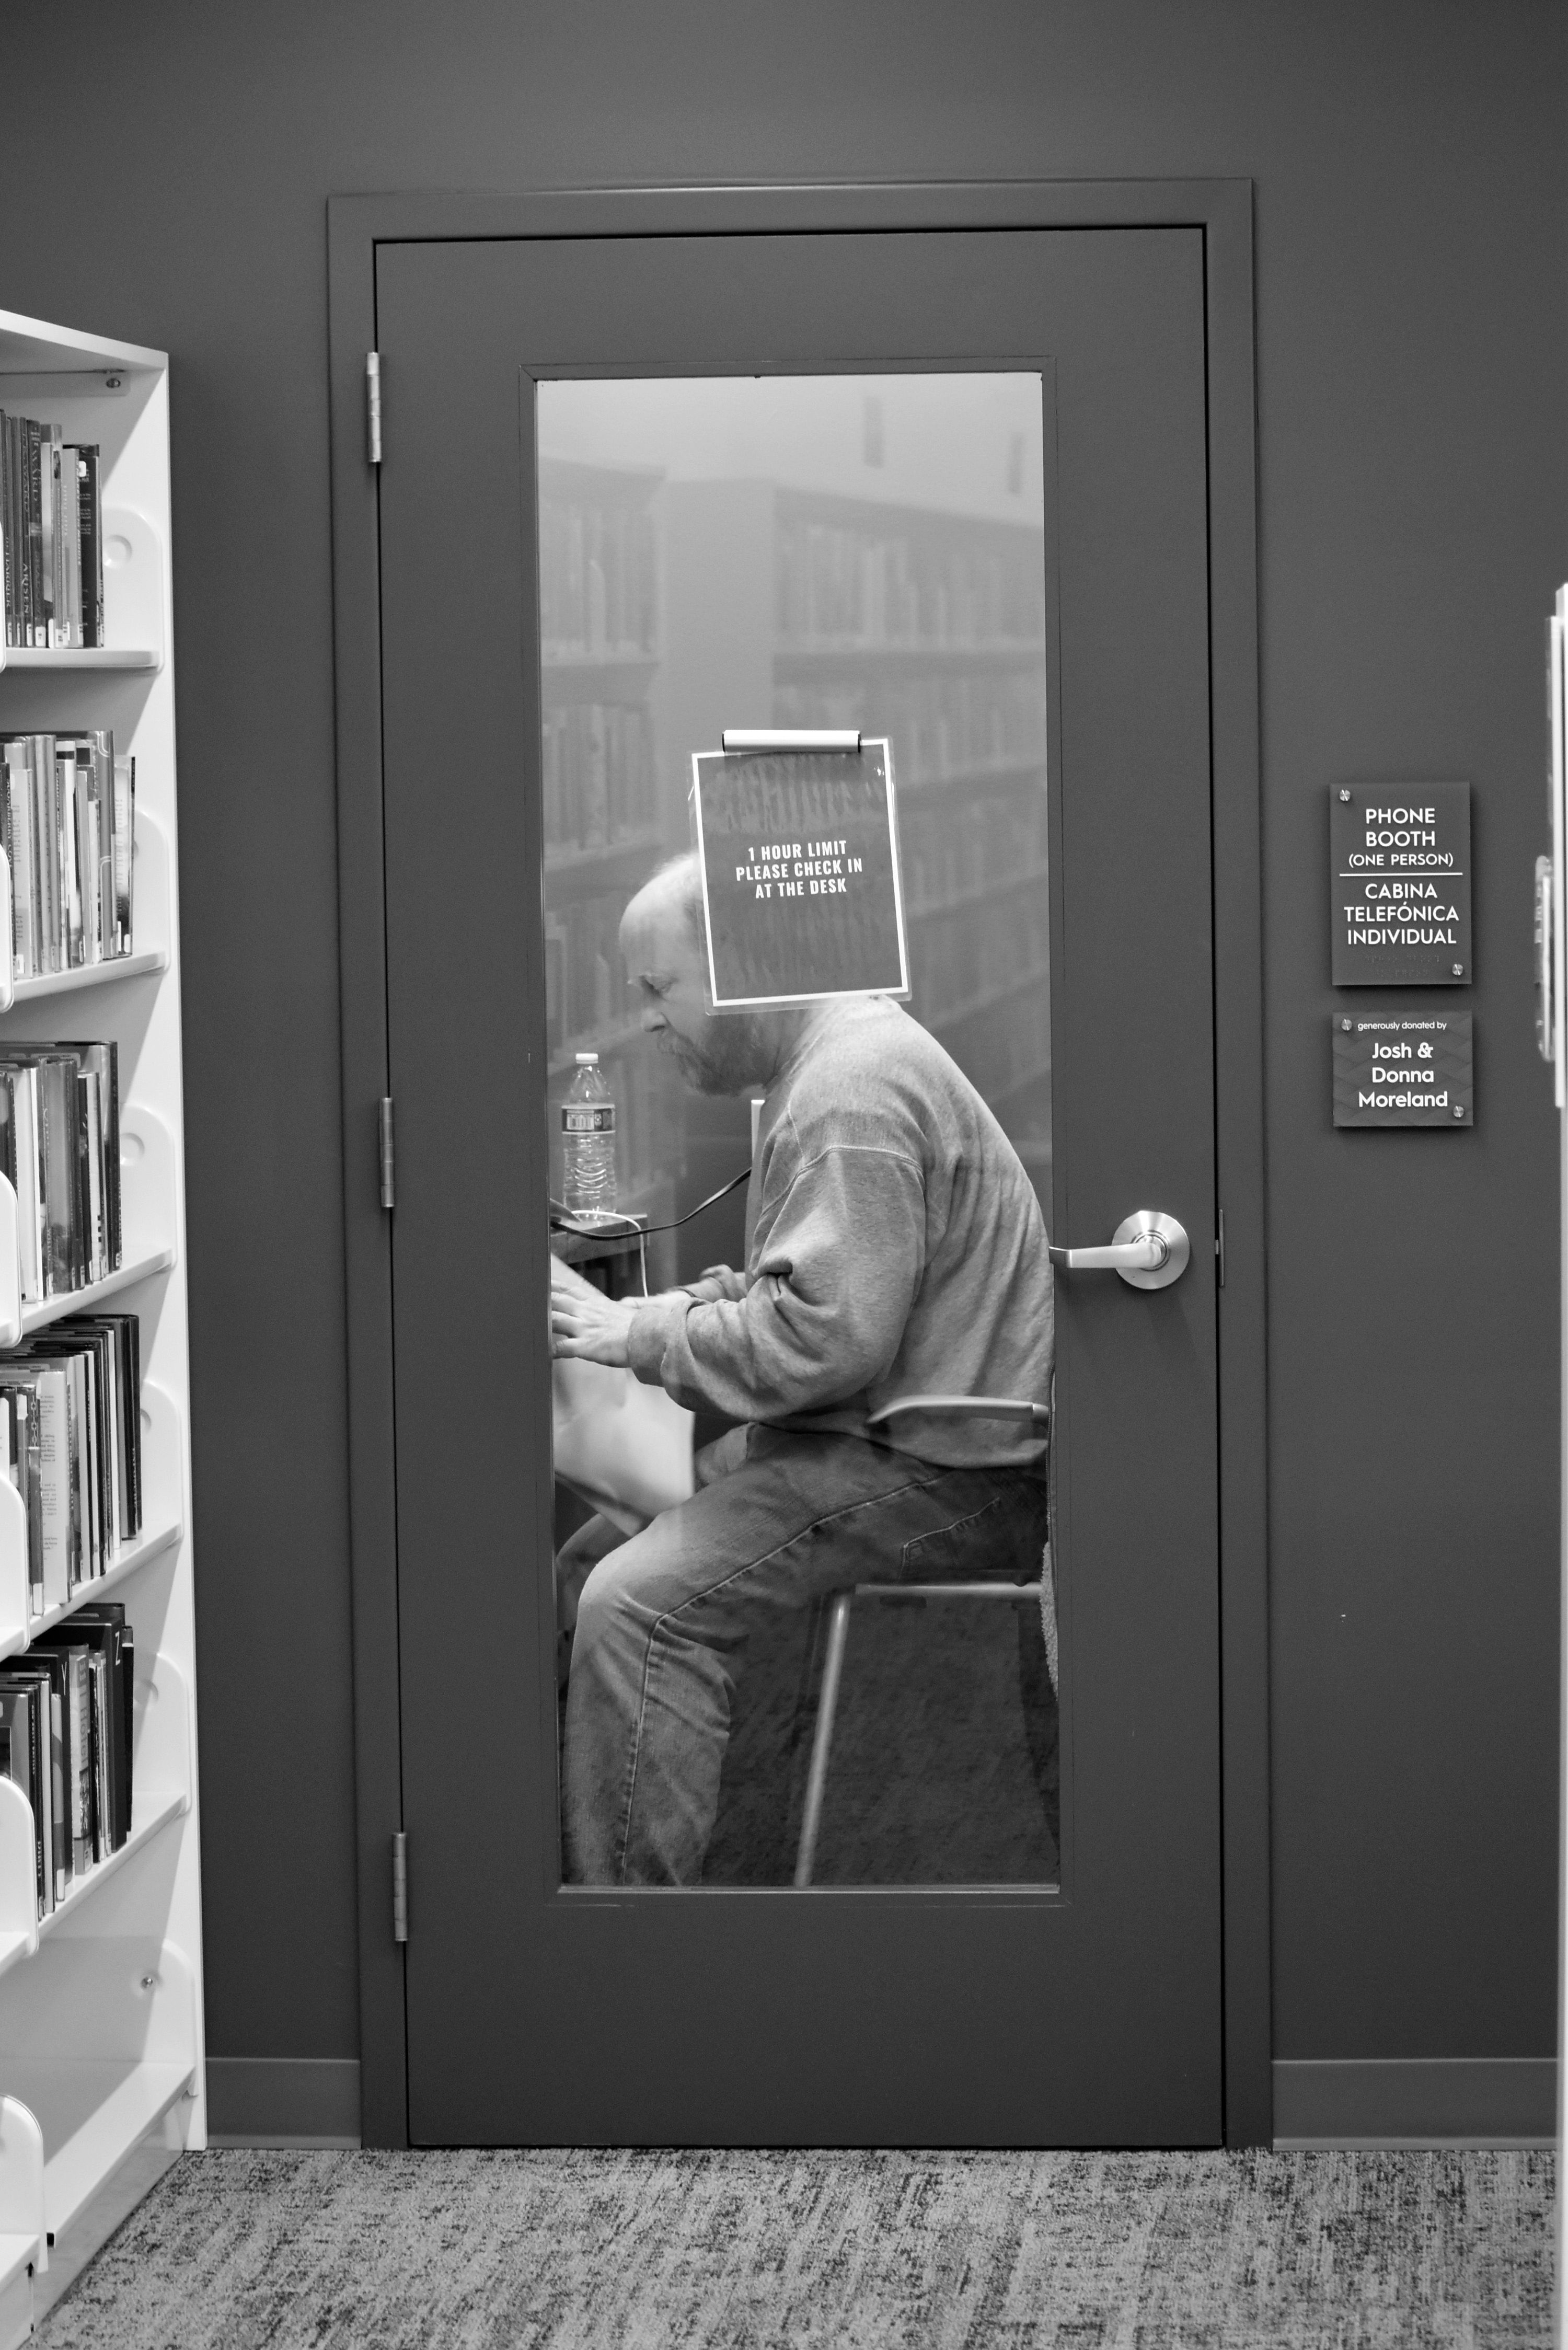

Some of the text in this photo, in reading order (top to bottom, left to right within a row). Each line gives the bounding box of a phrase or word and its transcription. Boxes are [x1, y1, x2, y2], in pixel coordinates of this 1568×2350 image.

[21, 563, 30, 614] ARISEN
[1366, 808, 1435, 824] PHONE
[1366, 831, 1435, 847] BOOTH
[748, 840, 847, 861] 1 HOUR LIMIT
[1349, 853, 1453, 868] (ONE PERSON)
[736, 858, 862, 881] PLEASE CHECK IN
[755, 878, 847, 899] AT THE DESK
[1365, 883, 1437, 899] CABINA
[1344, 901, 1459, 922] TELEFÓNICA
[1348, 929, 1457, 945] INDIVIDUAL
[1357, 1021, 1447, 1031] generously donated by
[1372, 1042, 1434, 1059] Josh &
[1372, 1067, 1434, 1083] Donna
[1359, 1091, 1448, 1108] Moreland
[114, 1631, 121, 1666] Z
[61, 1661, 68, 1696] Y
